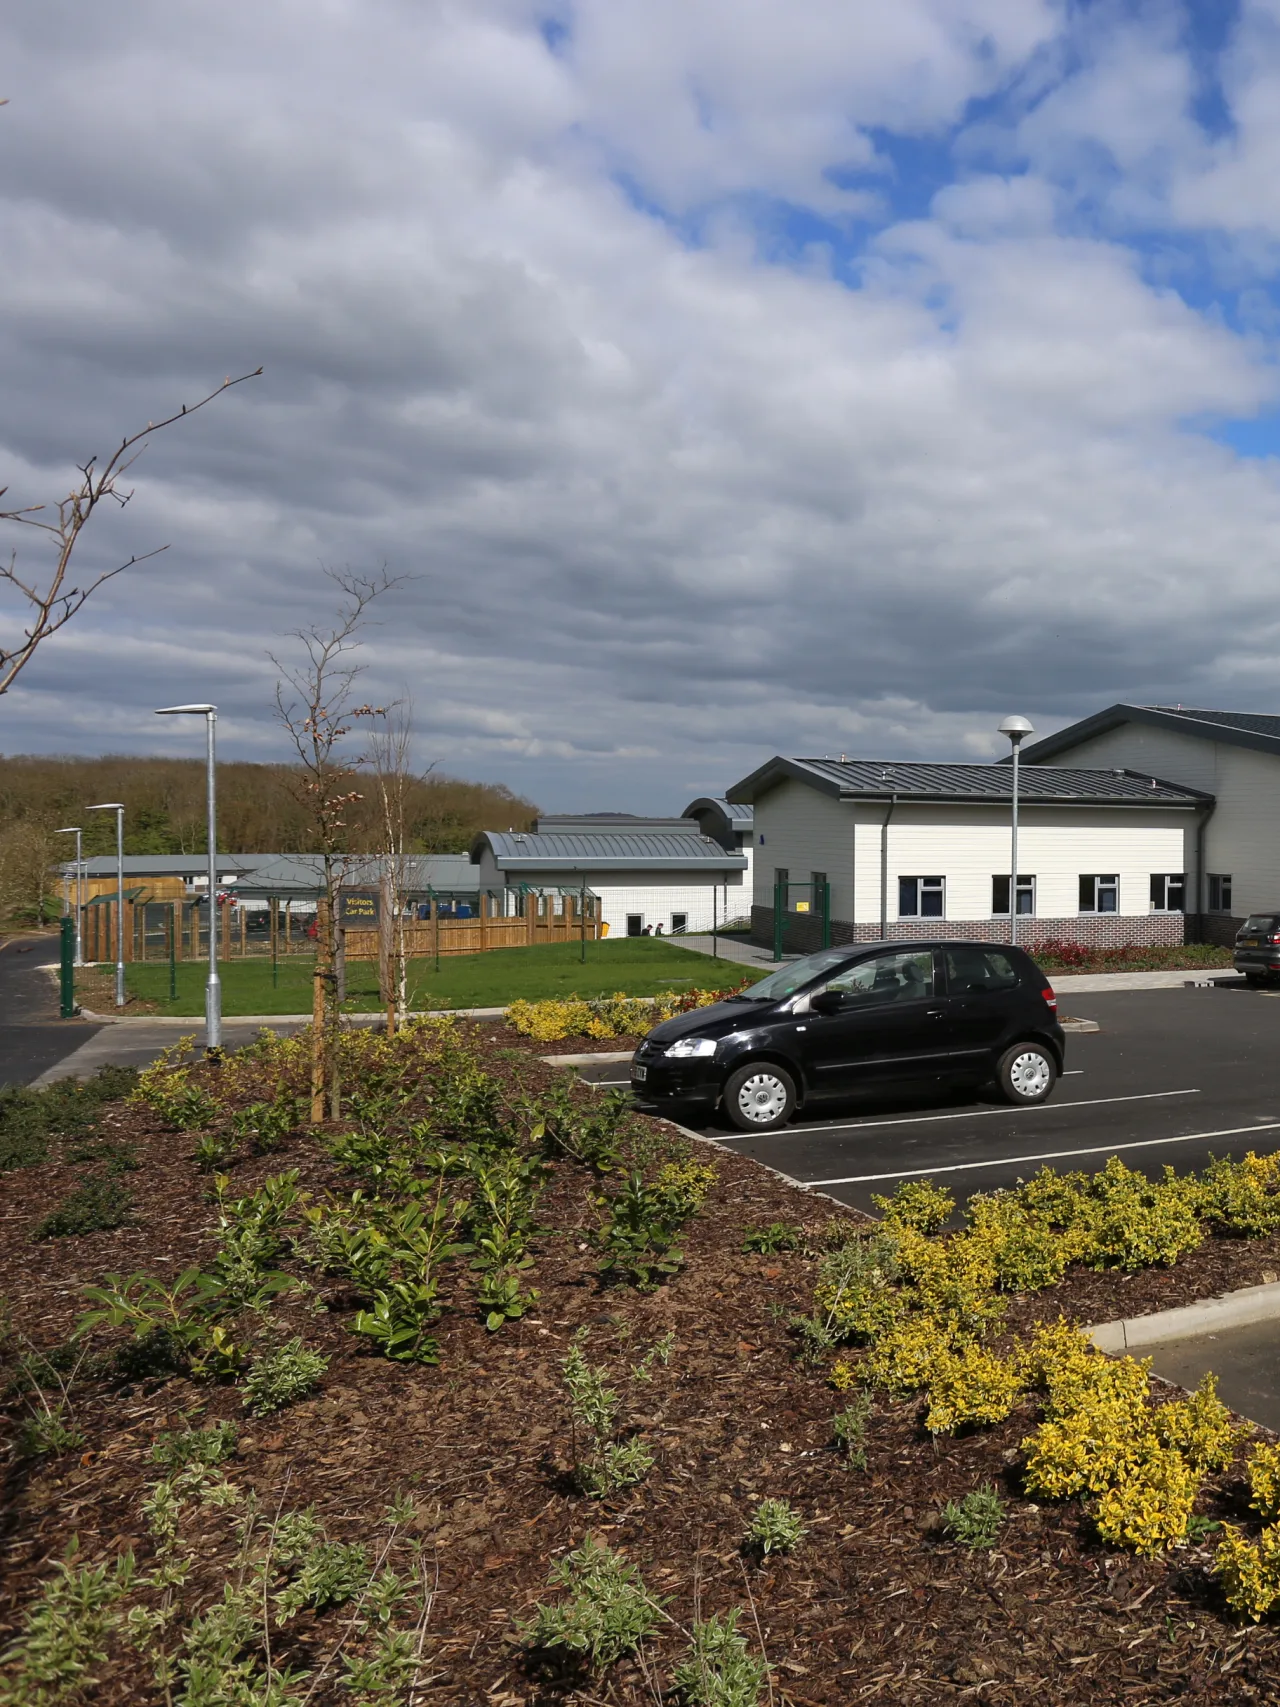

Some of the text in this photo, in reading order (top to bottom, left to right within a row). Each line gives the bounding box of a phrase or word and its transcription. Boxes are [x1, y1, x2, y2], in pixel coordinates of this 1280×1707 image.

[346, 898, 374, 906] Visitors
[345, 907, 375, 915] Car Park
